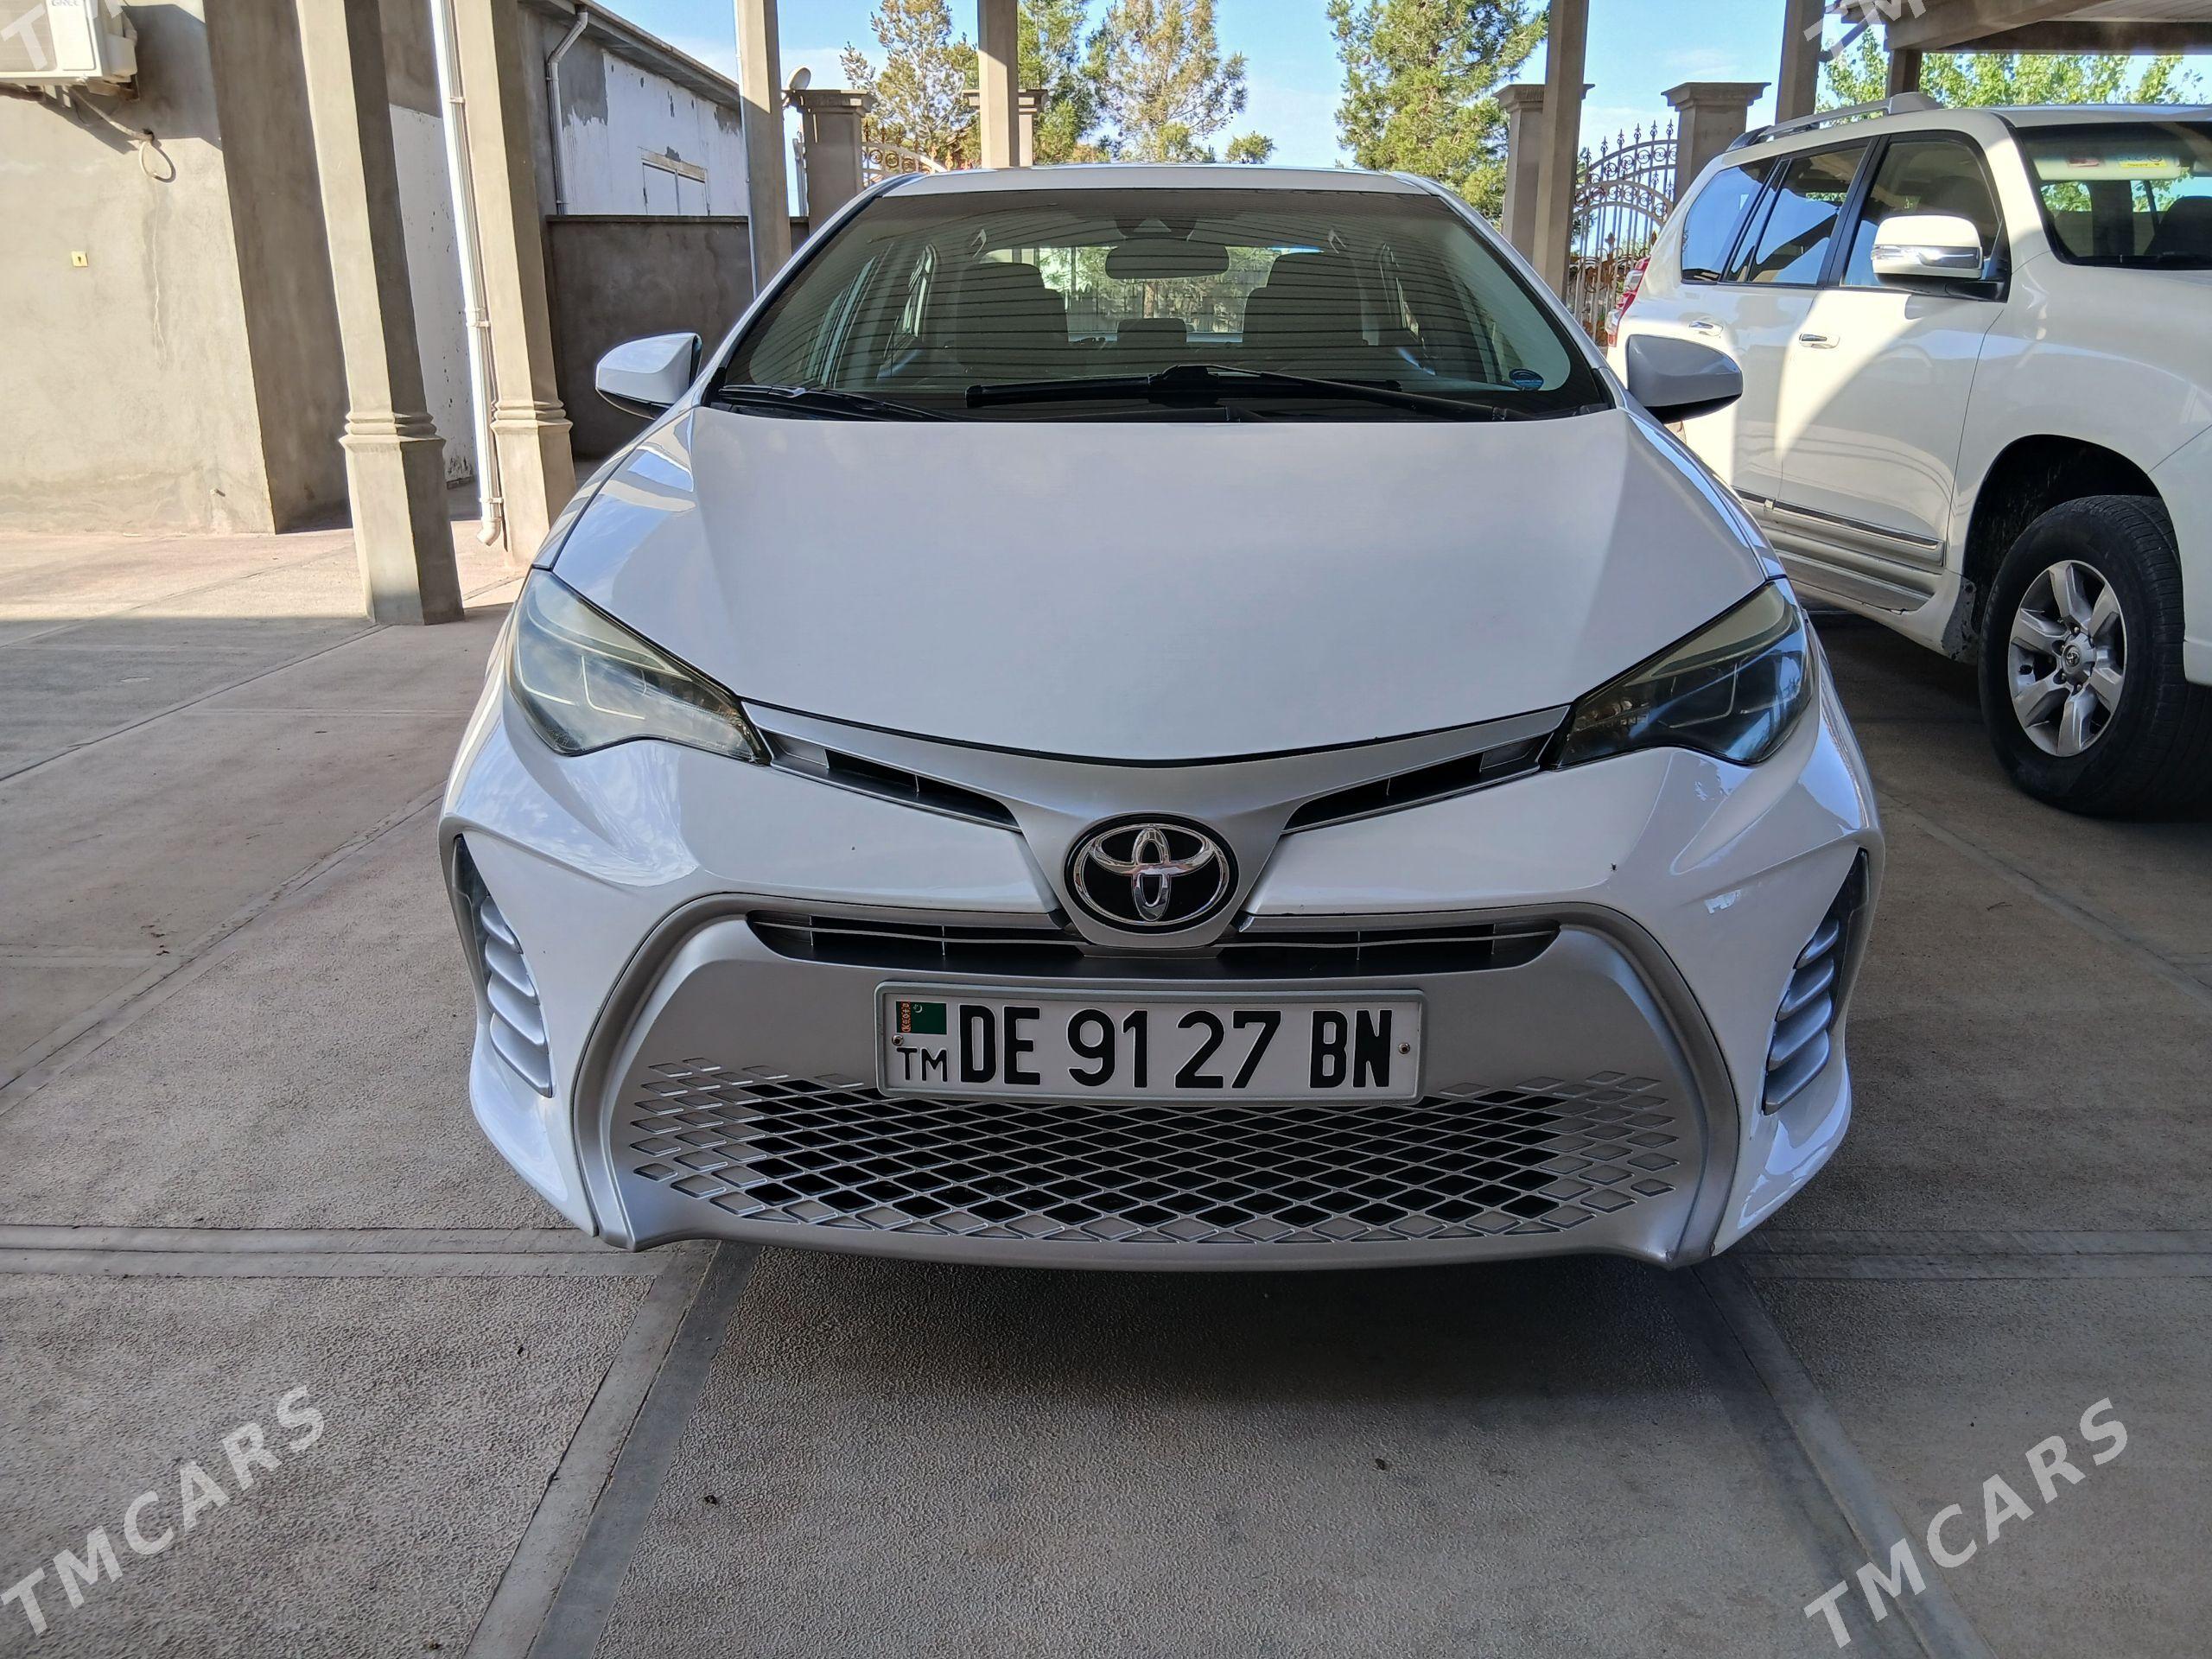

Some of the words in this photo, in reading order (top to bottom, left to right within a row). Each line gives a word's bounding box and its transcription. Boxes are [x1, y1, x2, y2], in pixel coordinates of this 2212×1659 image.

[896, 1046, 949, 1082] TM
[958, 1003, 1041, 1086] DE
[1065, 1008, 1149, 1089] 91
[1174, 1010, 1282, 1089] 27
[1308, 1009, 1394, 1089] BN
